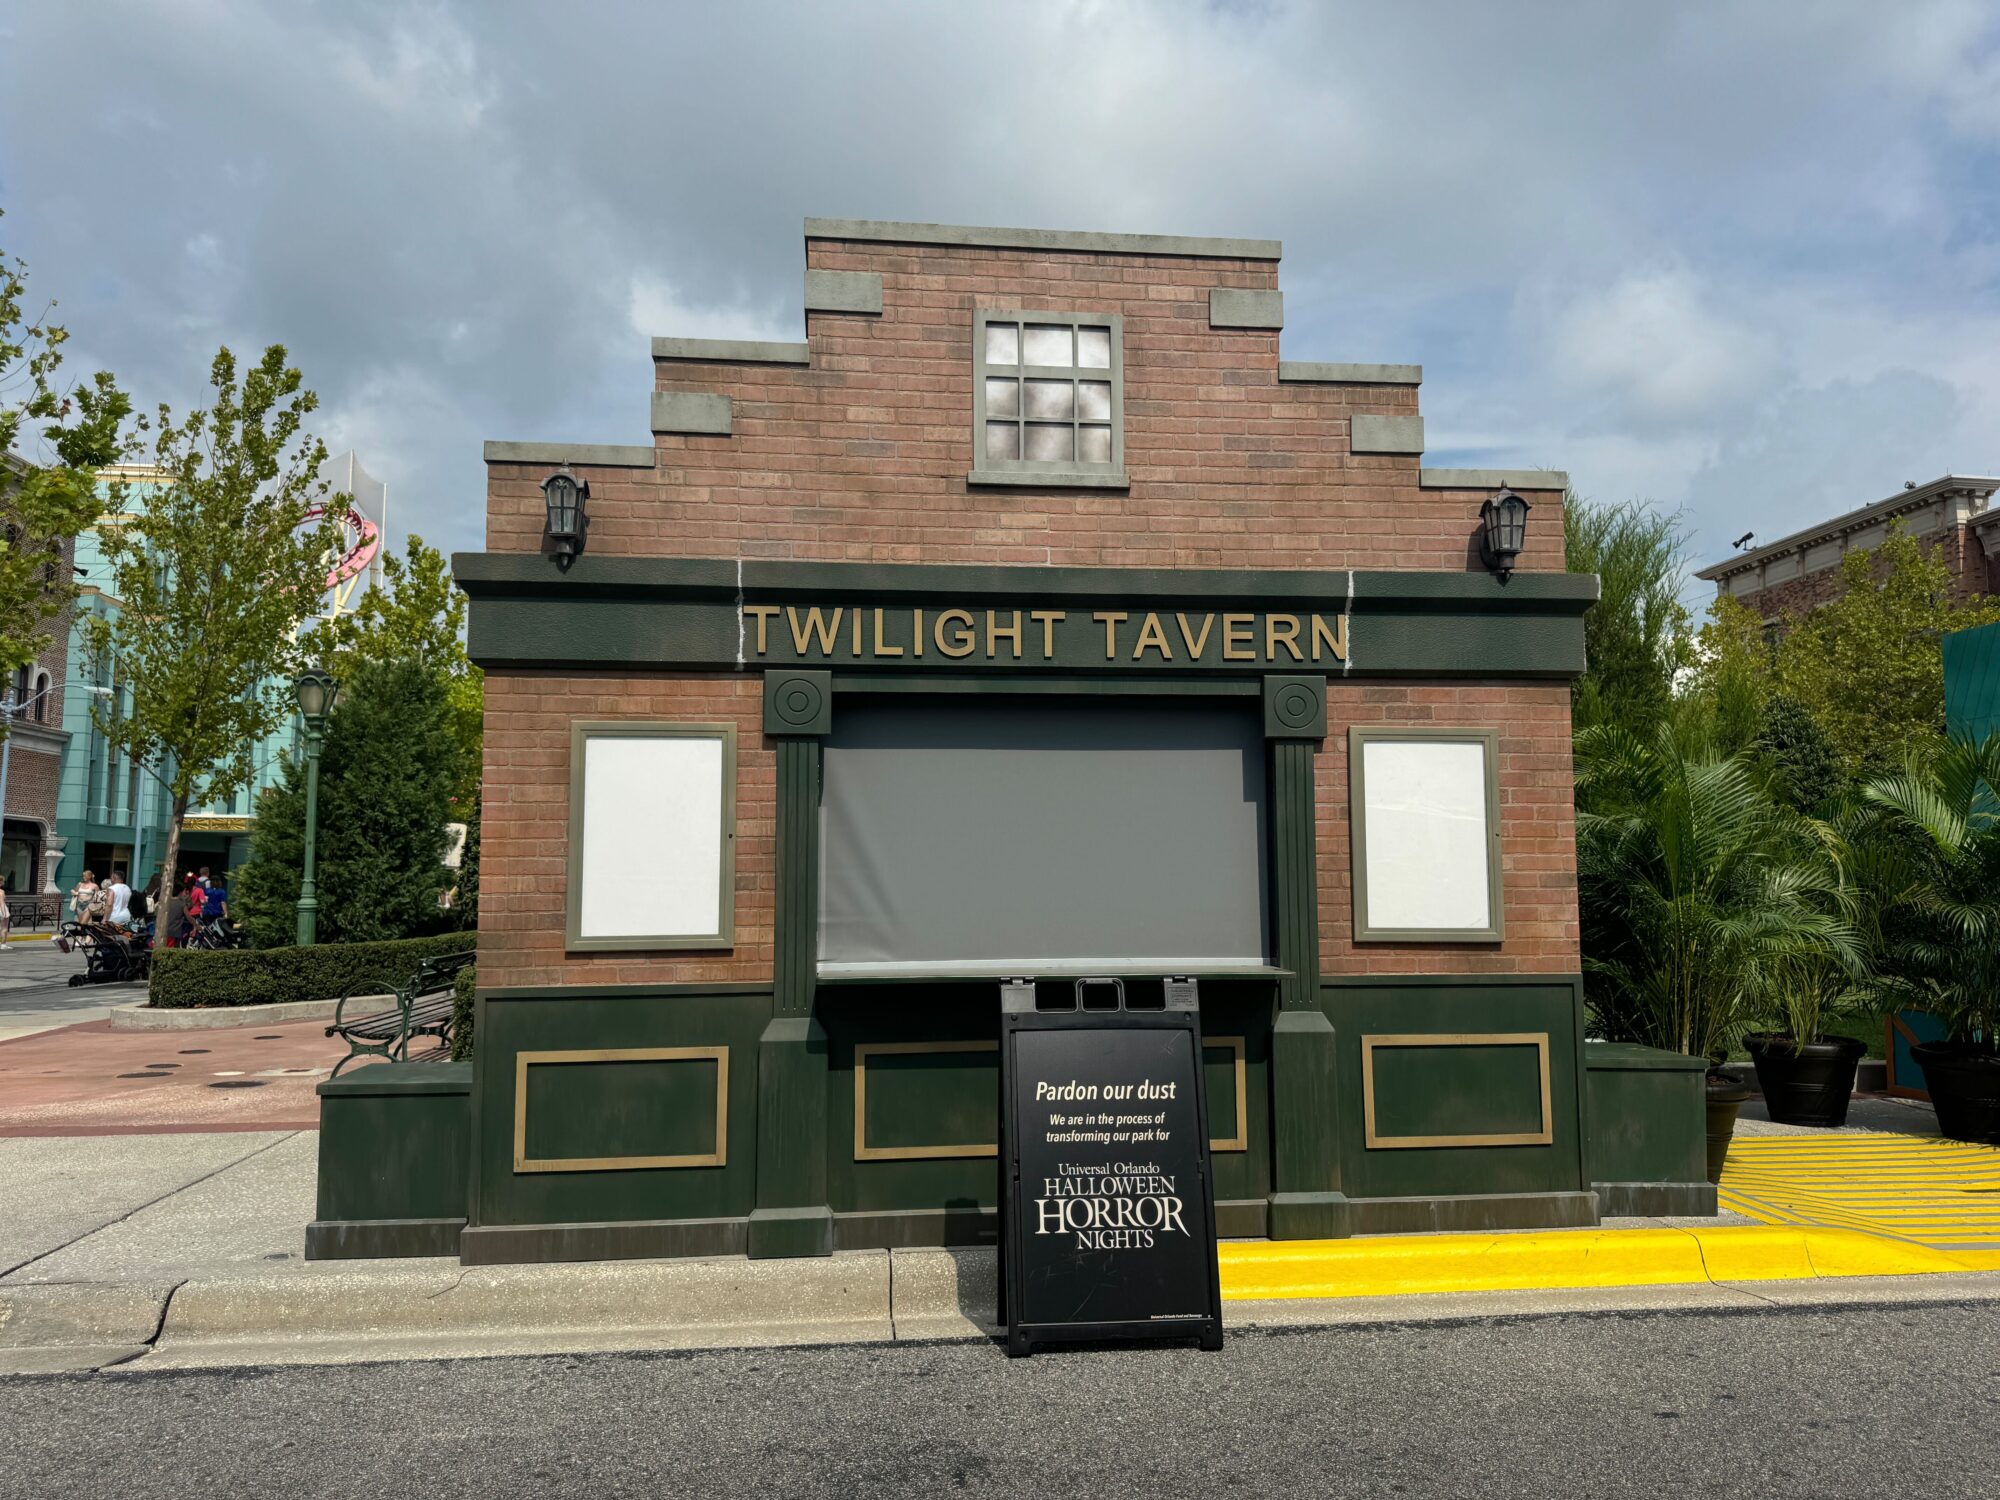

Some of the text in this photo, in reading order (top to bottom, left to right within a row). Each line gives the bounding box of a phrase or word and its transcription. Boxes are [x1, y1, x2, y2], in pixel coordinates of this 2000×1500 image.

[743, 605, 1348, 661] TWILIGHT TAVERN
[1035, 1078, 1177, 1101] Pardon our dust
[1049, 1111, 1166, 1128] We are in the process of
[1046, 1128, 1170, 1144] transforming our park for
[1058, 1161, 1160, 1176] Universal Orlando
[1043, 1175, 1176, 1197] HALLOWEEN
[1034, 1196, 1191, 1238] HORROR
[1077, 1229, 1154, 1250] NIGHTS
